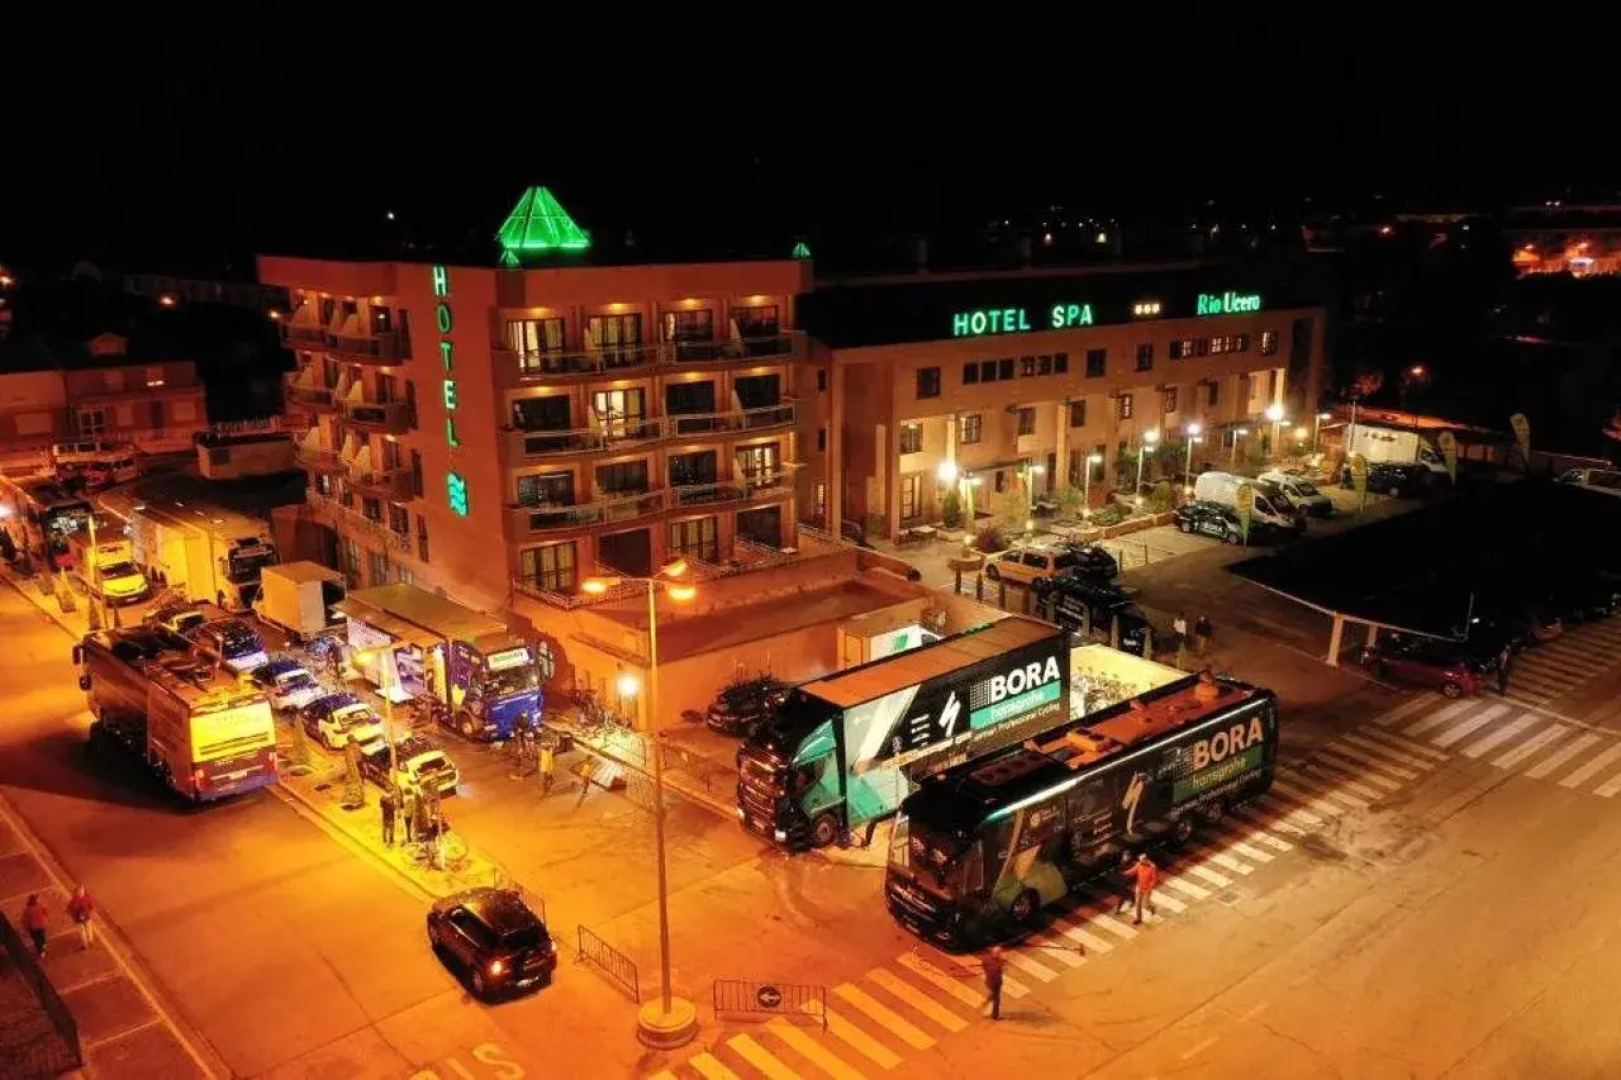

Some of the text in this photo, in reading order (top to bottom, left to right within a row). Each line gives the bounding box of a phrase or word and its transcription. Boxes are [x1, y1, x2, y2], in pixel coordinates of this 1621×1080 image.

[953, 304, 1094, 336] HOTEL SPA
[432, 265, 459, 447] HOTEL
[990, 655, 1061, 703] BORA
[1192, 717, 1264, 771] BORA
